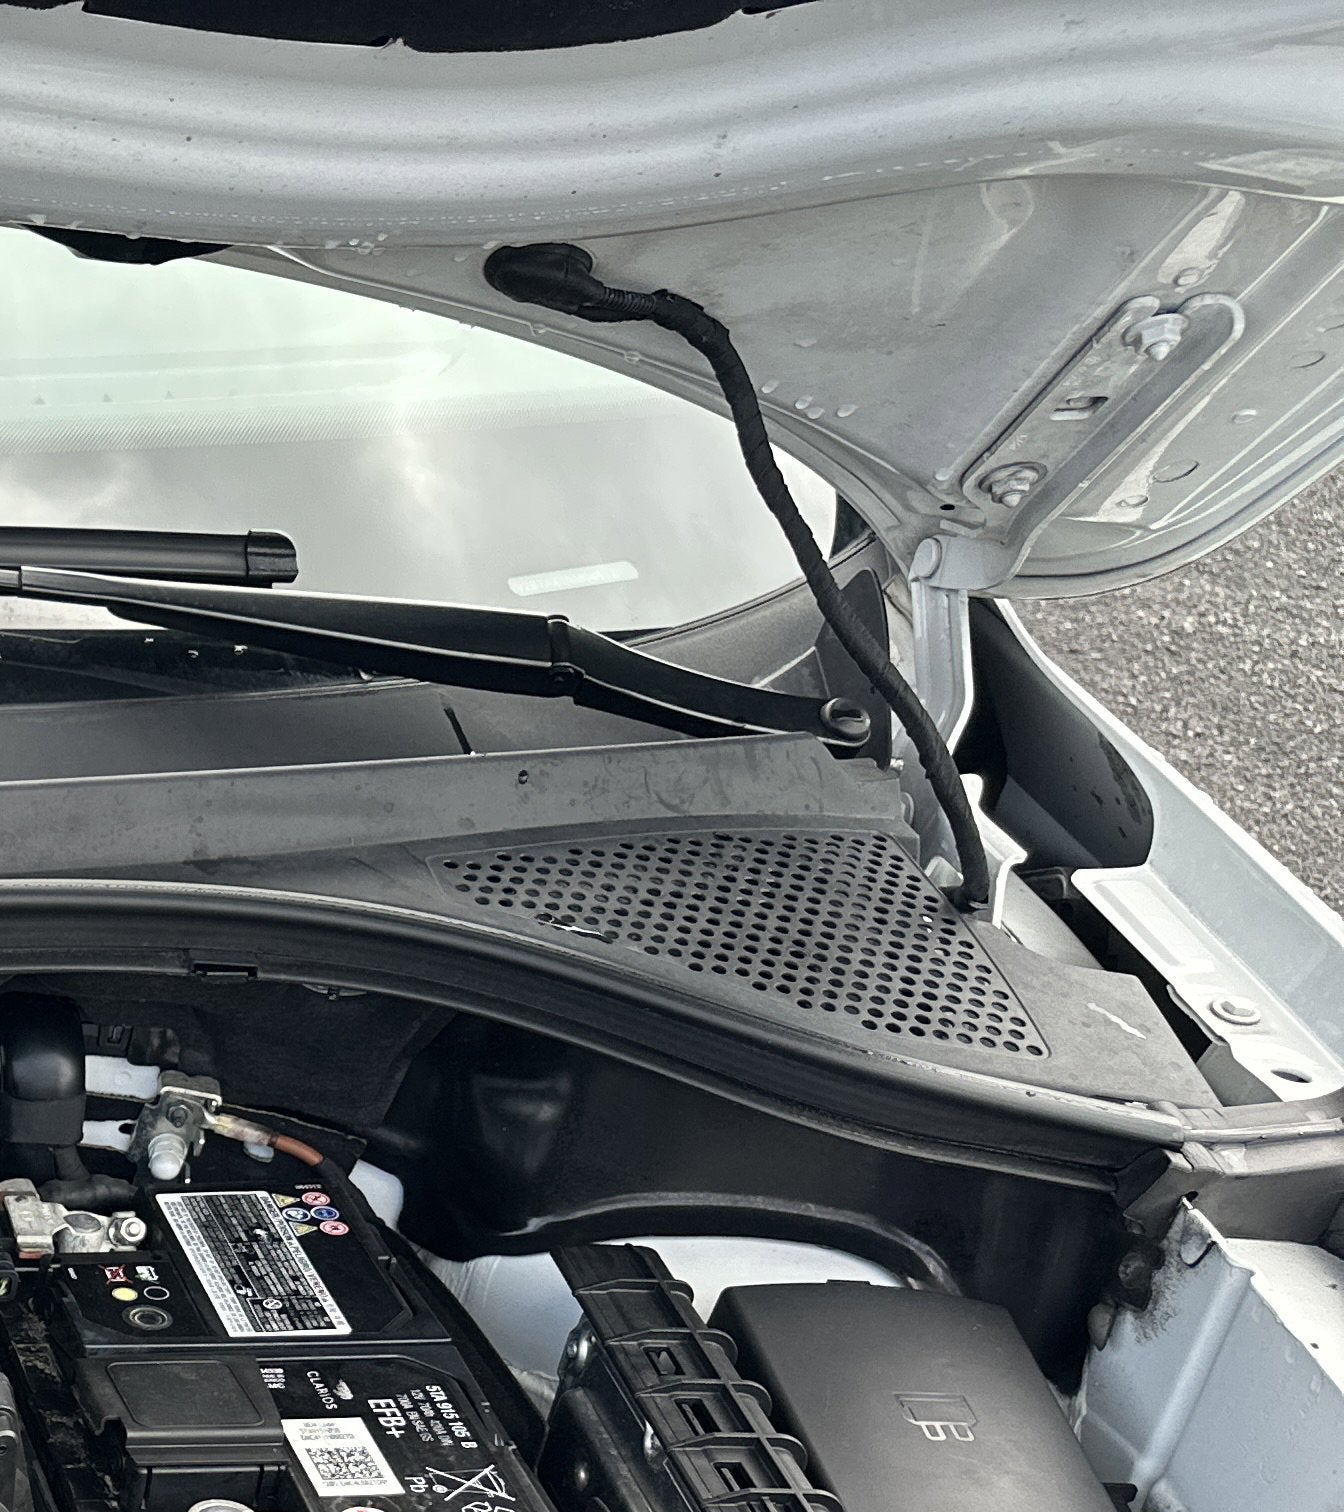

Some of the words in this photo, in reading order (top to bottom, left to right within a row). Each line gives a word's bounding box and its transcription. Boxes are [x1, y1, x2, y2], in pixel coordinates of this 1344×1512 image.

[306, 1370, 338, 1410] CLARIOS
[368, 1398, 406, 1439] EFB+
[436, 1402, 460, 1419] 915
[448, 1421, 471, 1437] 105
[405, 1476, 425, 1493] Pb
